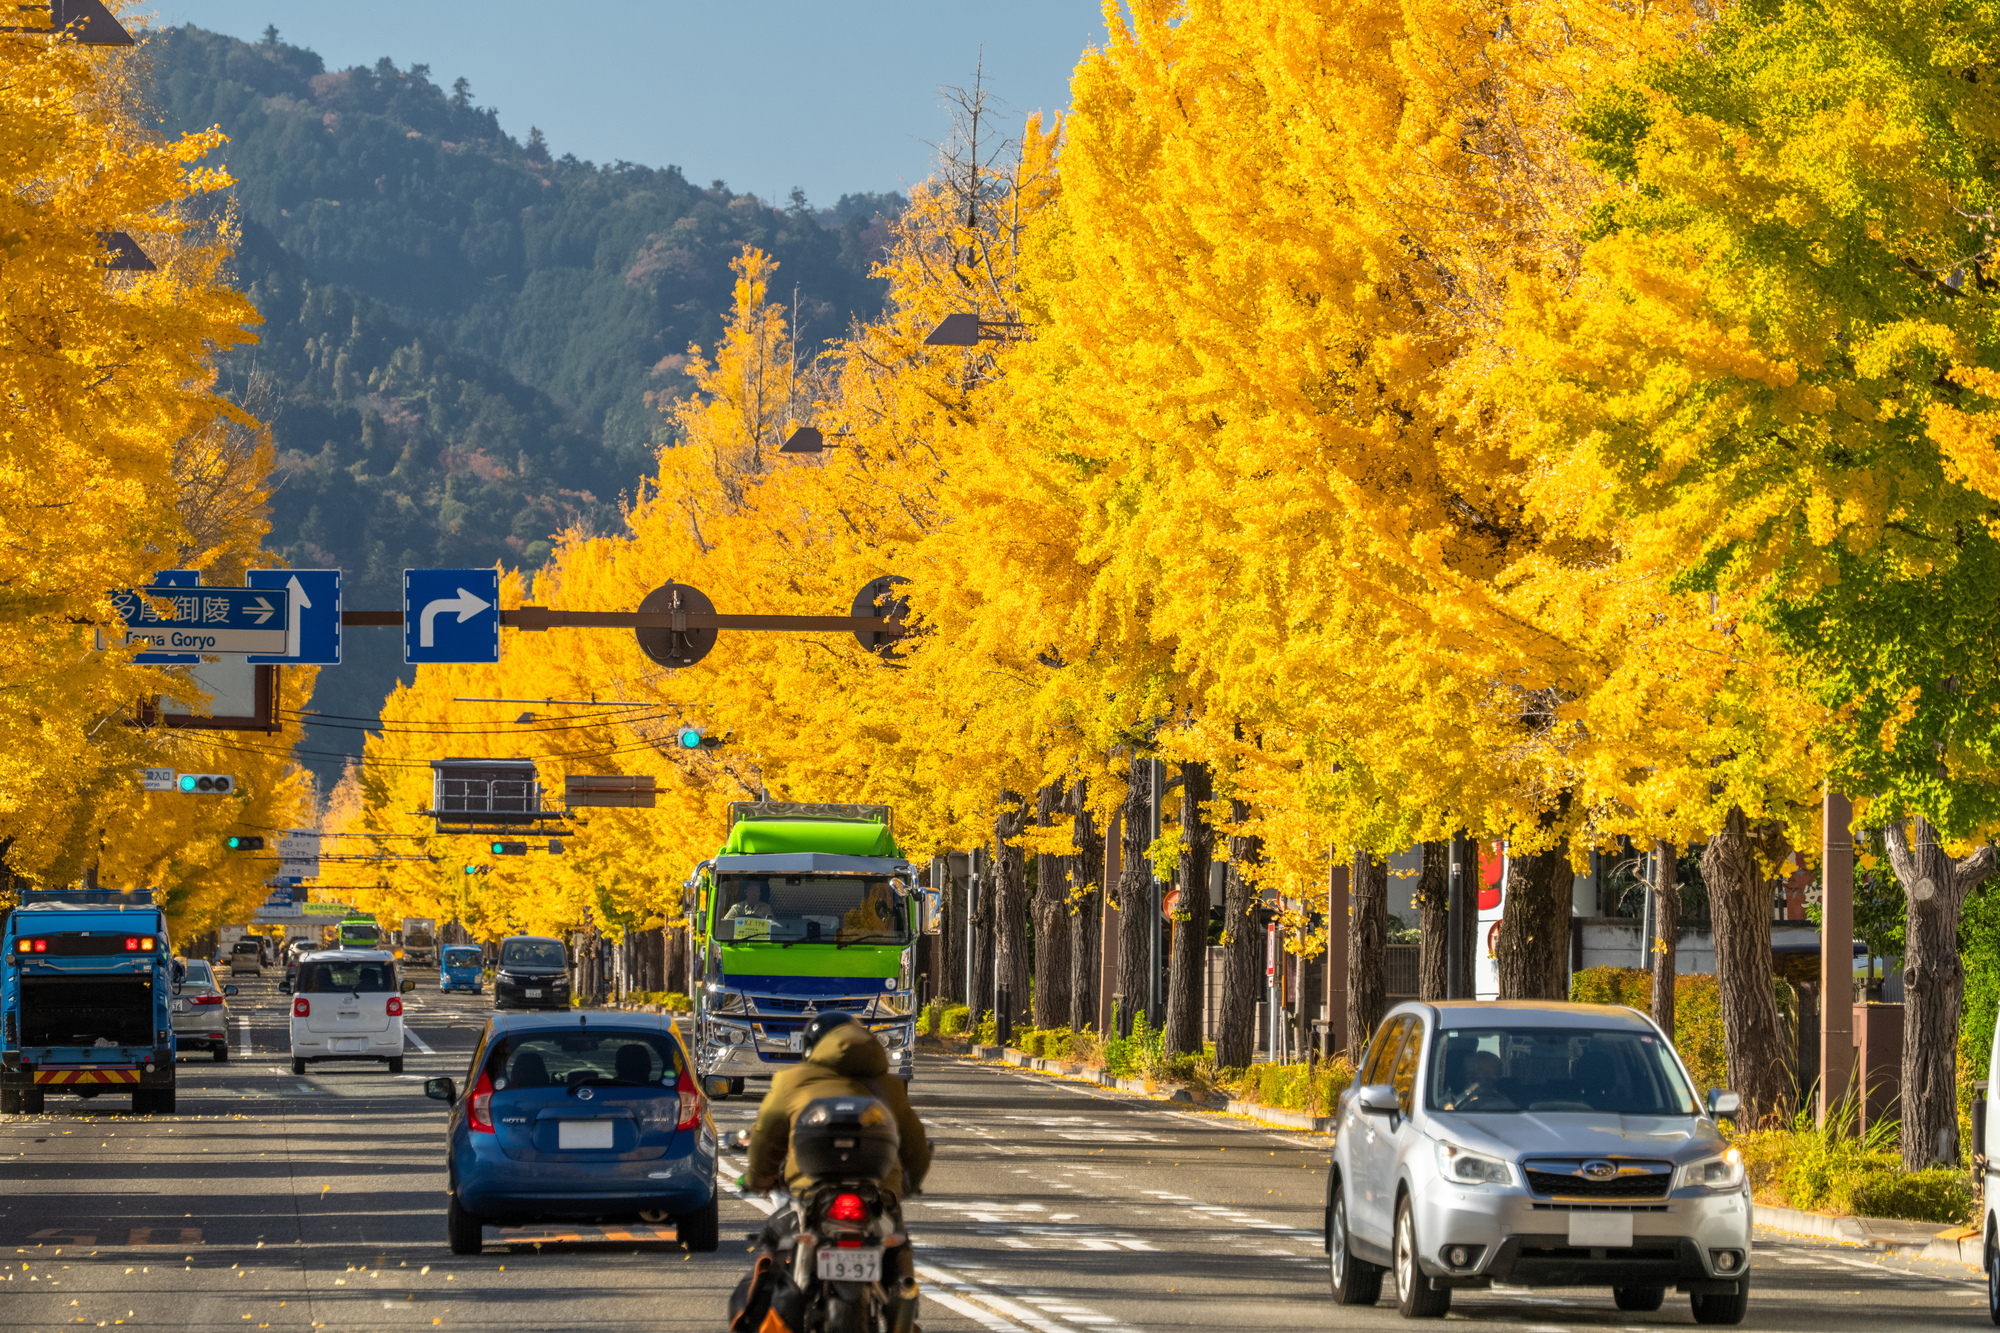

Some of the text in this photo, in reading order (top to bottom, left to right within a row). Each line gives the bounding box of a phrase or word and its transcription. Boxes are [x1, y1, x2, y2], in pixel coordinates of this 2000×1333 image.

[111, 594, 230, 624] 多摩御陵
[171, 632, 216, 650] Goryo
